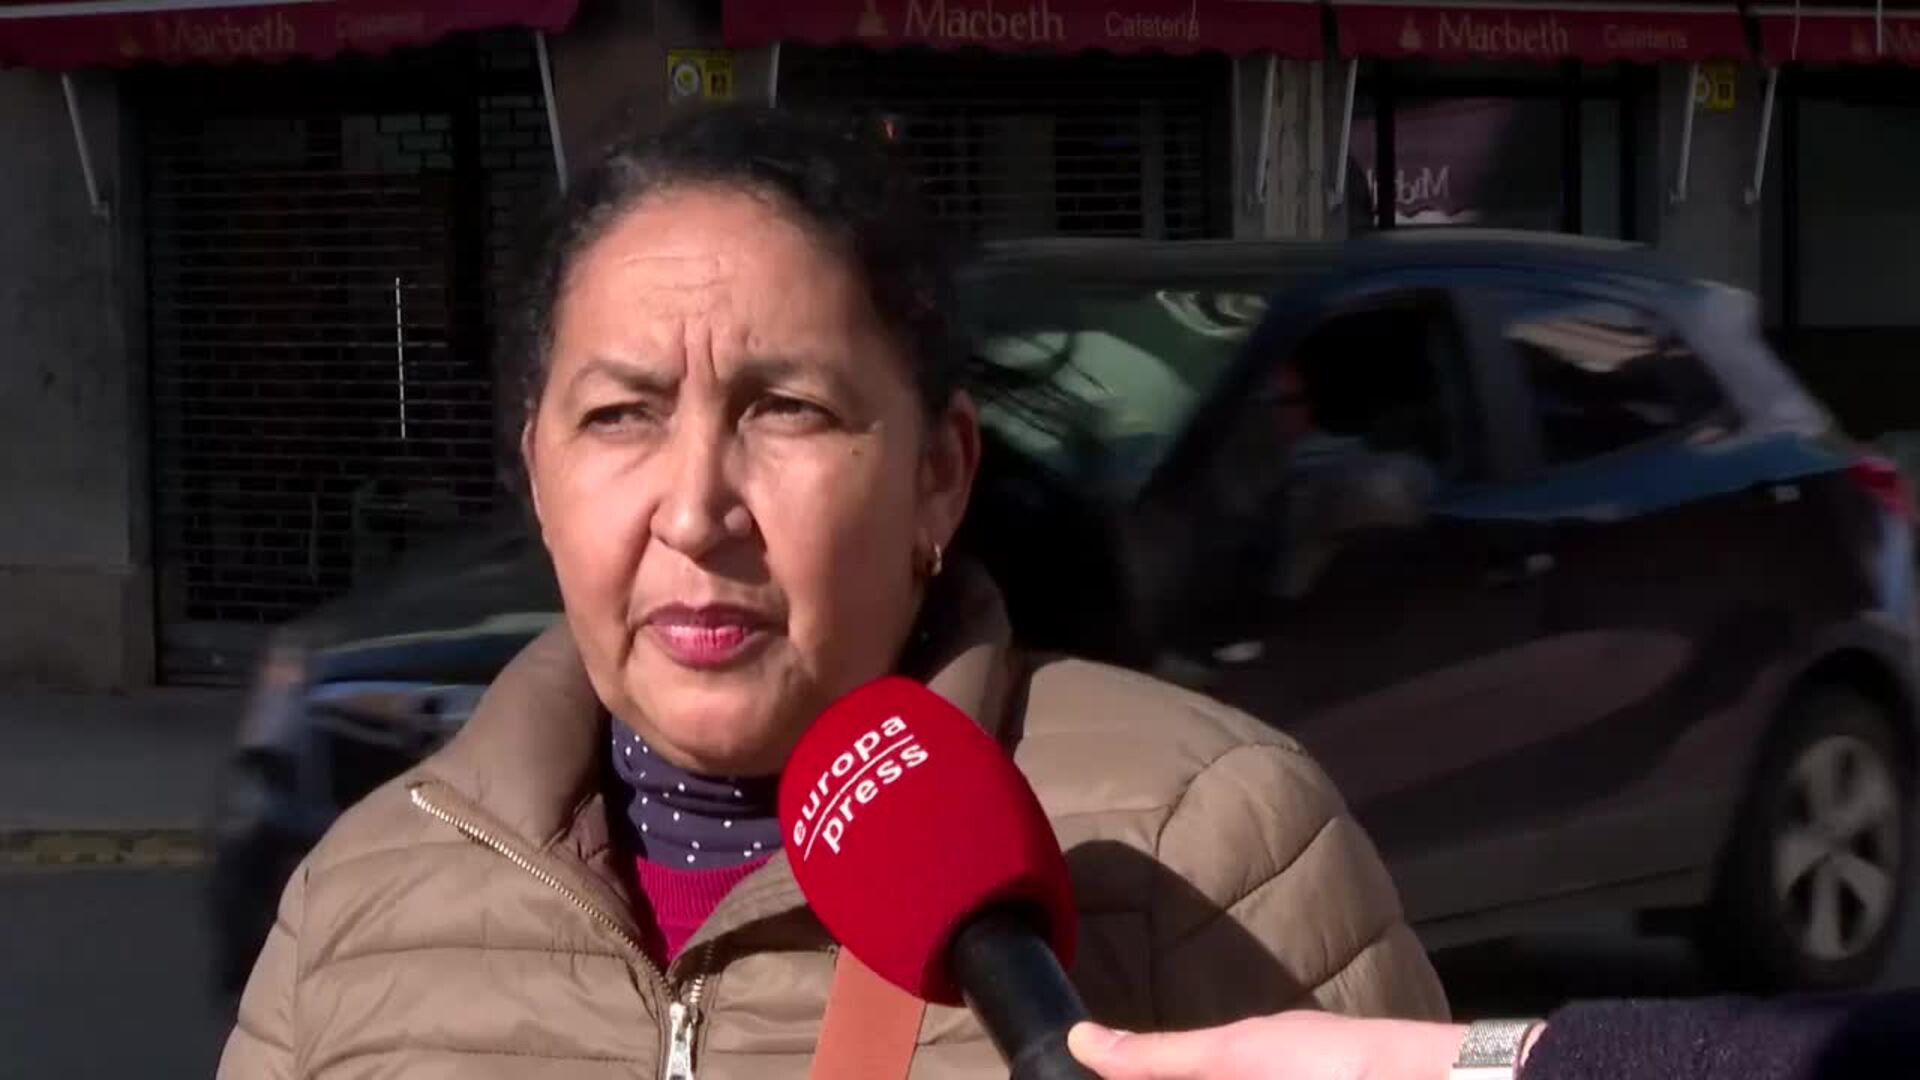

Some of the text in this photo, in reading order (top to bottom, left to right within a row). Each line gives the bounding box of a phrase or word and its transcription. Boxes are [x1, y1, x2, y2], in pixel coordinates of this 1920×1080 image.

[154, 14, 297, 56] Macbeth
[903, 0, 1066, 42] Macbeth
[1438, 13, 1570, 54] Macbeth
[793, 715, 907, 847] europa
[821, 743, 929, 855] press
